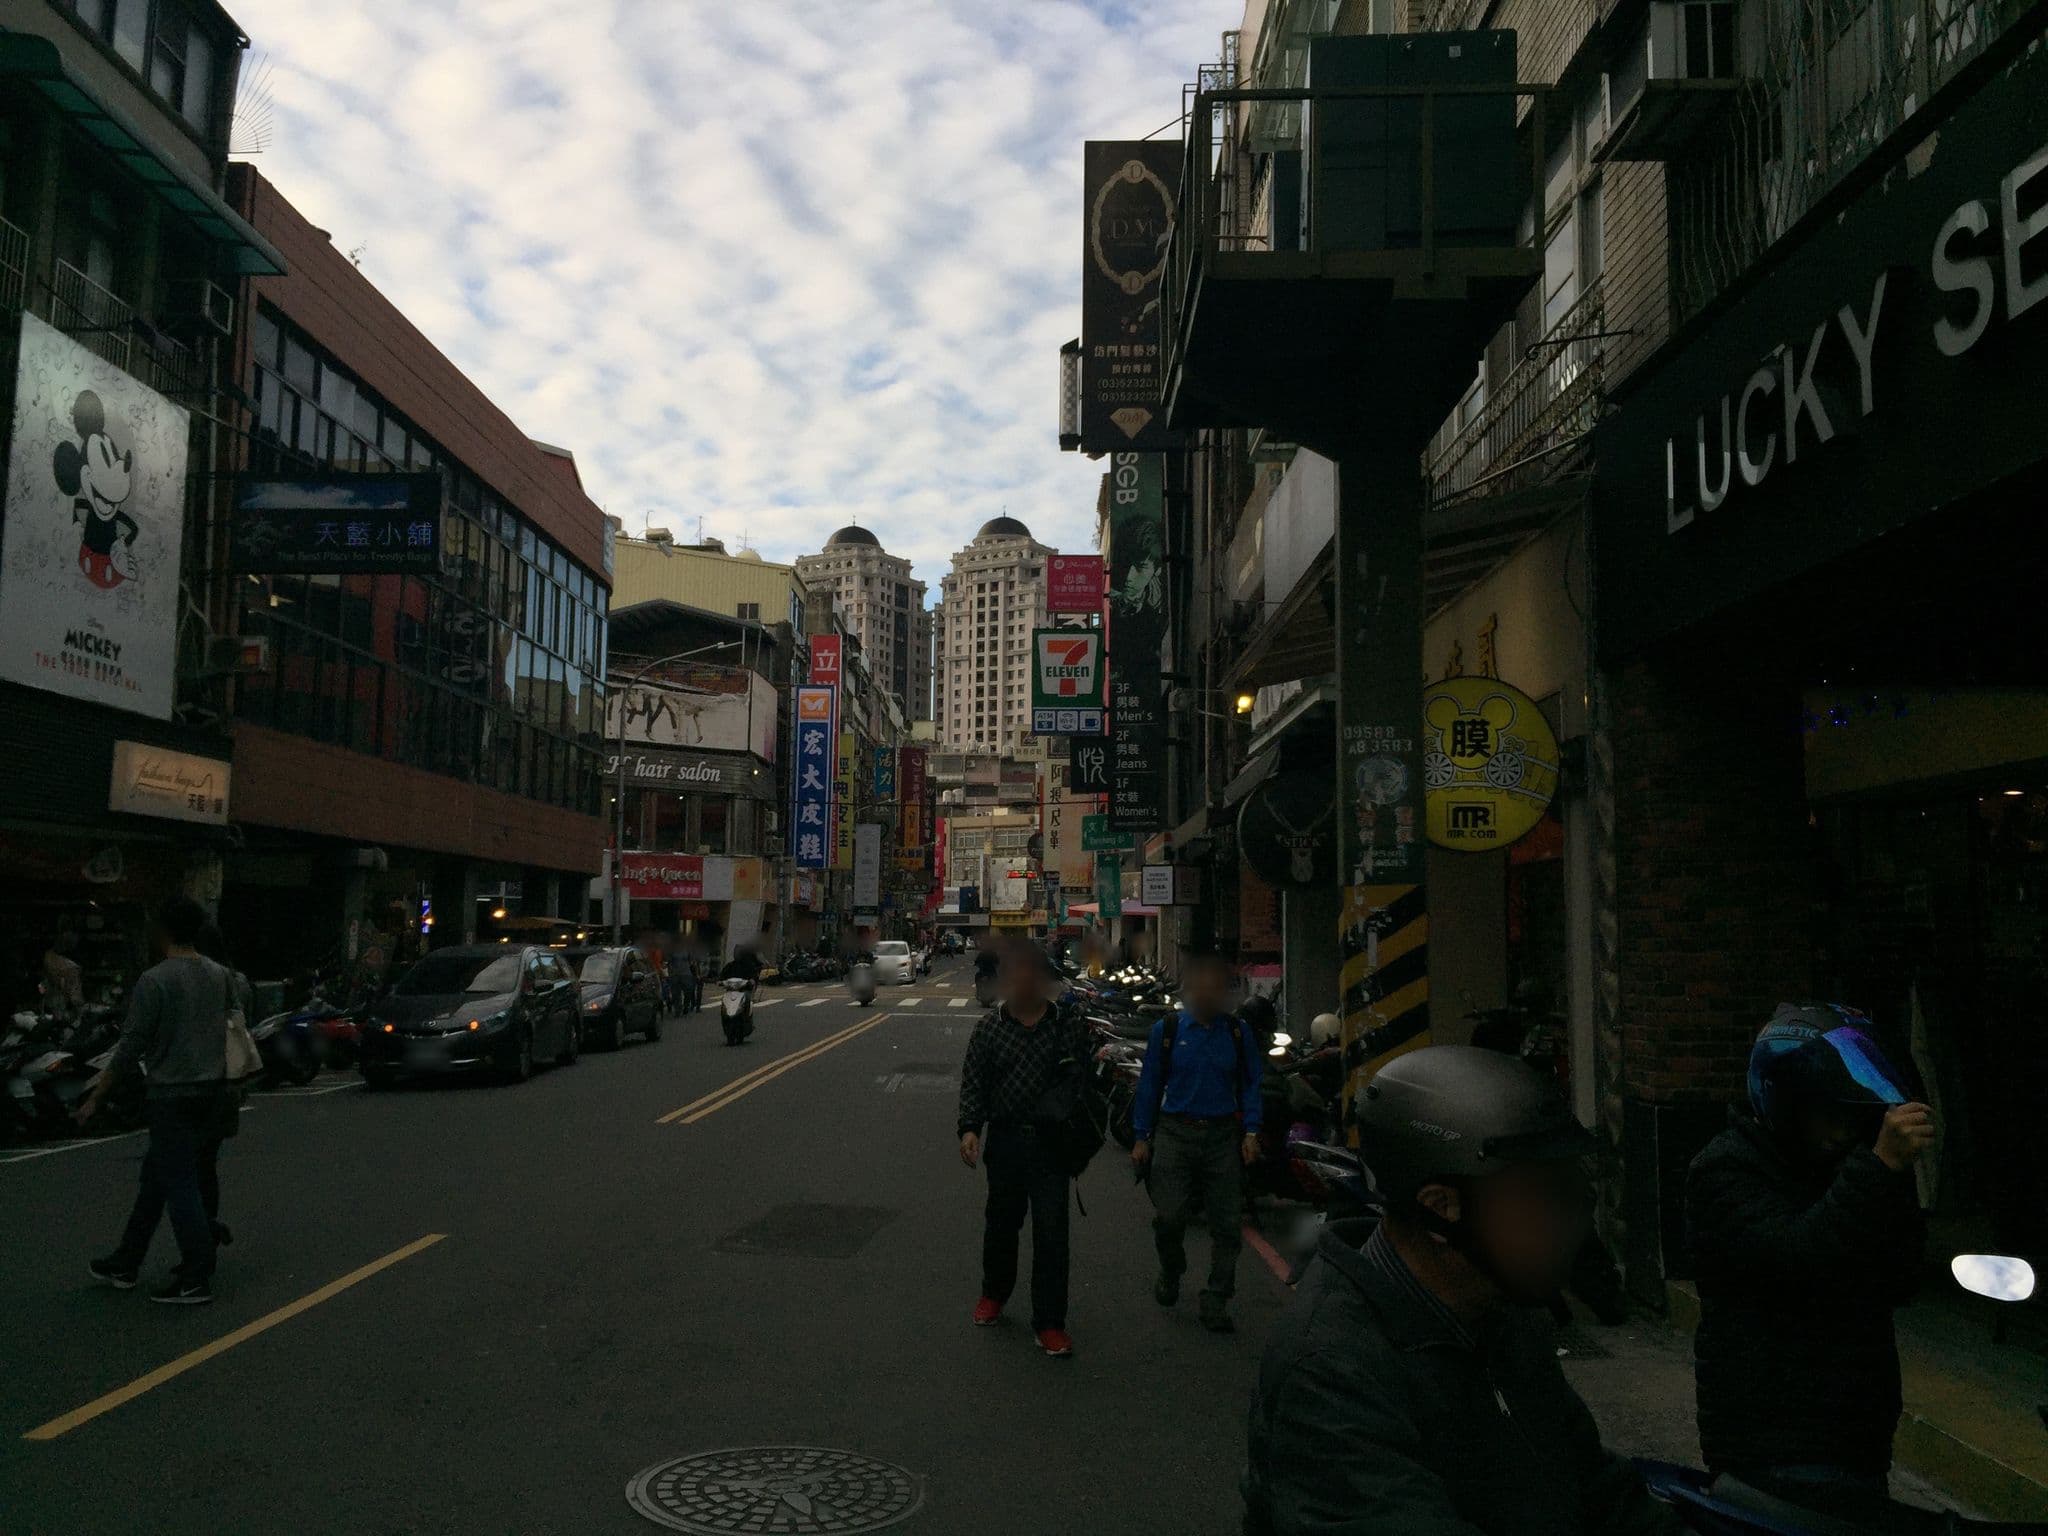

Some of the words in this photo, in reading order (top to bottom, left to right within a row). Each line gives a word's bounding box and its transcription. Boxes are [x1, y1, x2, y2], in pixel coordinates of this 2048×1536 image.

[1667, 271, 1888, 536] LUCKY
[1116, 452, 1139, 505] SGB
[64, 629, 122, 661] MICKEY
[815, 650, 838, 685] 立
[1115, 683, 1130, 694] 3F
[1115, 730, 1129, 741] 2F
[1451, 718, 1491, 758] 膜
[634, 755, 672, 779] hair
[677, 761, 721, 782] salon
[1115, 758, 1148, 769] Jeans
[799, 728, 824, 861] 宏大皮鞋
[1115, 777, 1129, 789] 1F
[660, 866, 702, 885] Queen
